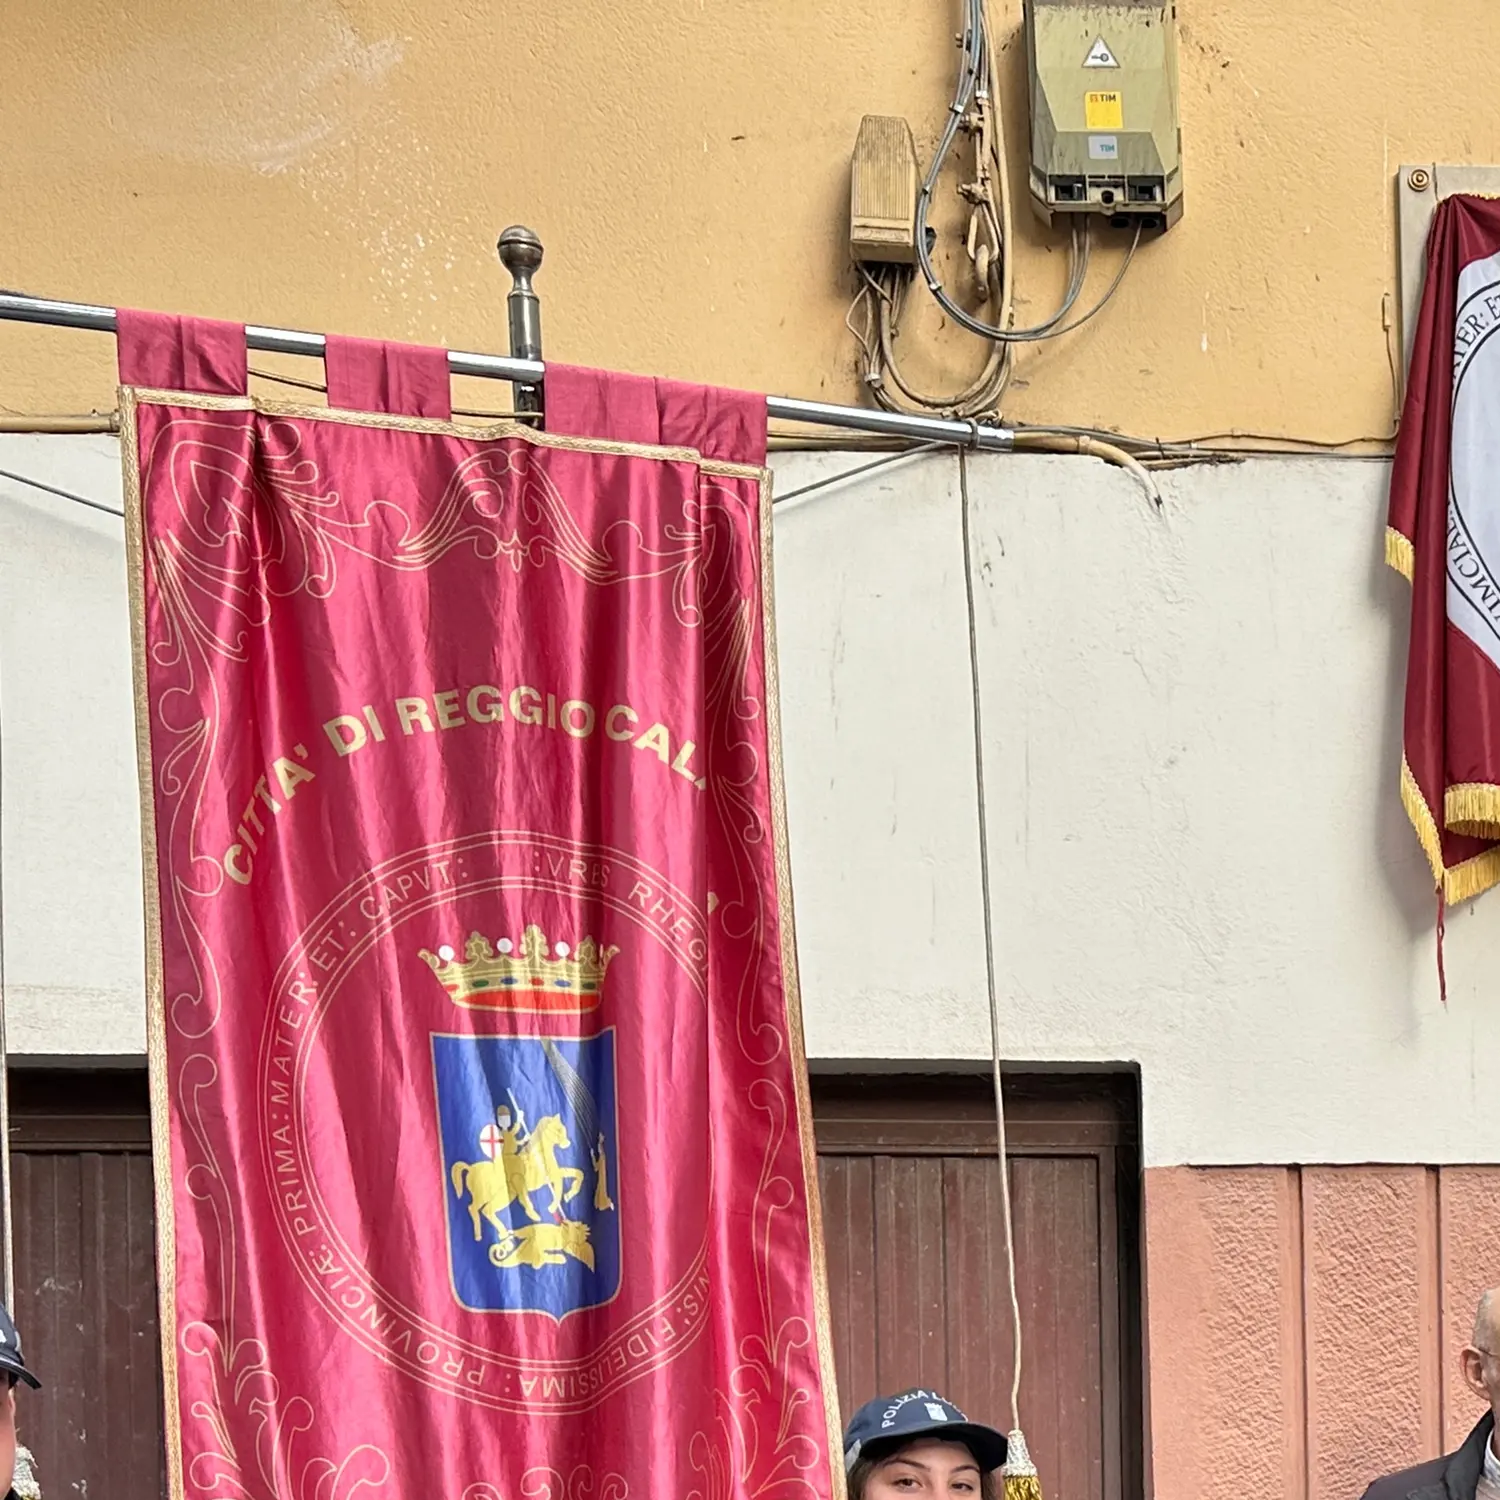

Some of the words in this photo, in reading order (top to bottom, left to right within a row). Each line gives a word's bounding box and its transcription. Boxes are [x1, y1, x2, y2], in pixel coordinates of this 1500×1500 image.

[1100, 94, 1116, 102] TIM
[223, 743, 316, 886] CITTA'
[322, 704, 386, 757] DI
[395, 684, 596, 738] REGGIO
[881, 1389, 929, 1429] POLIZIA
